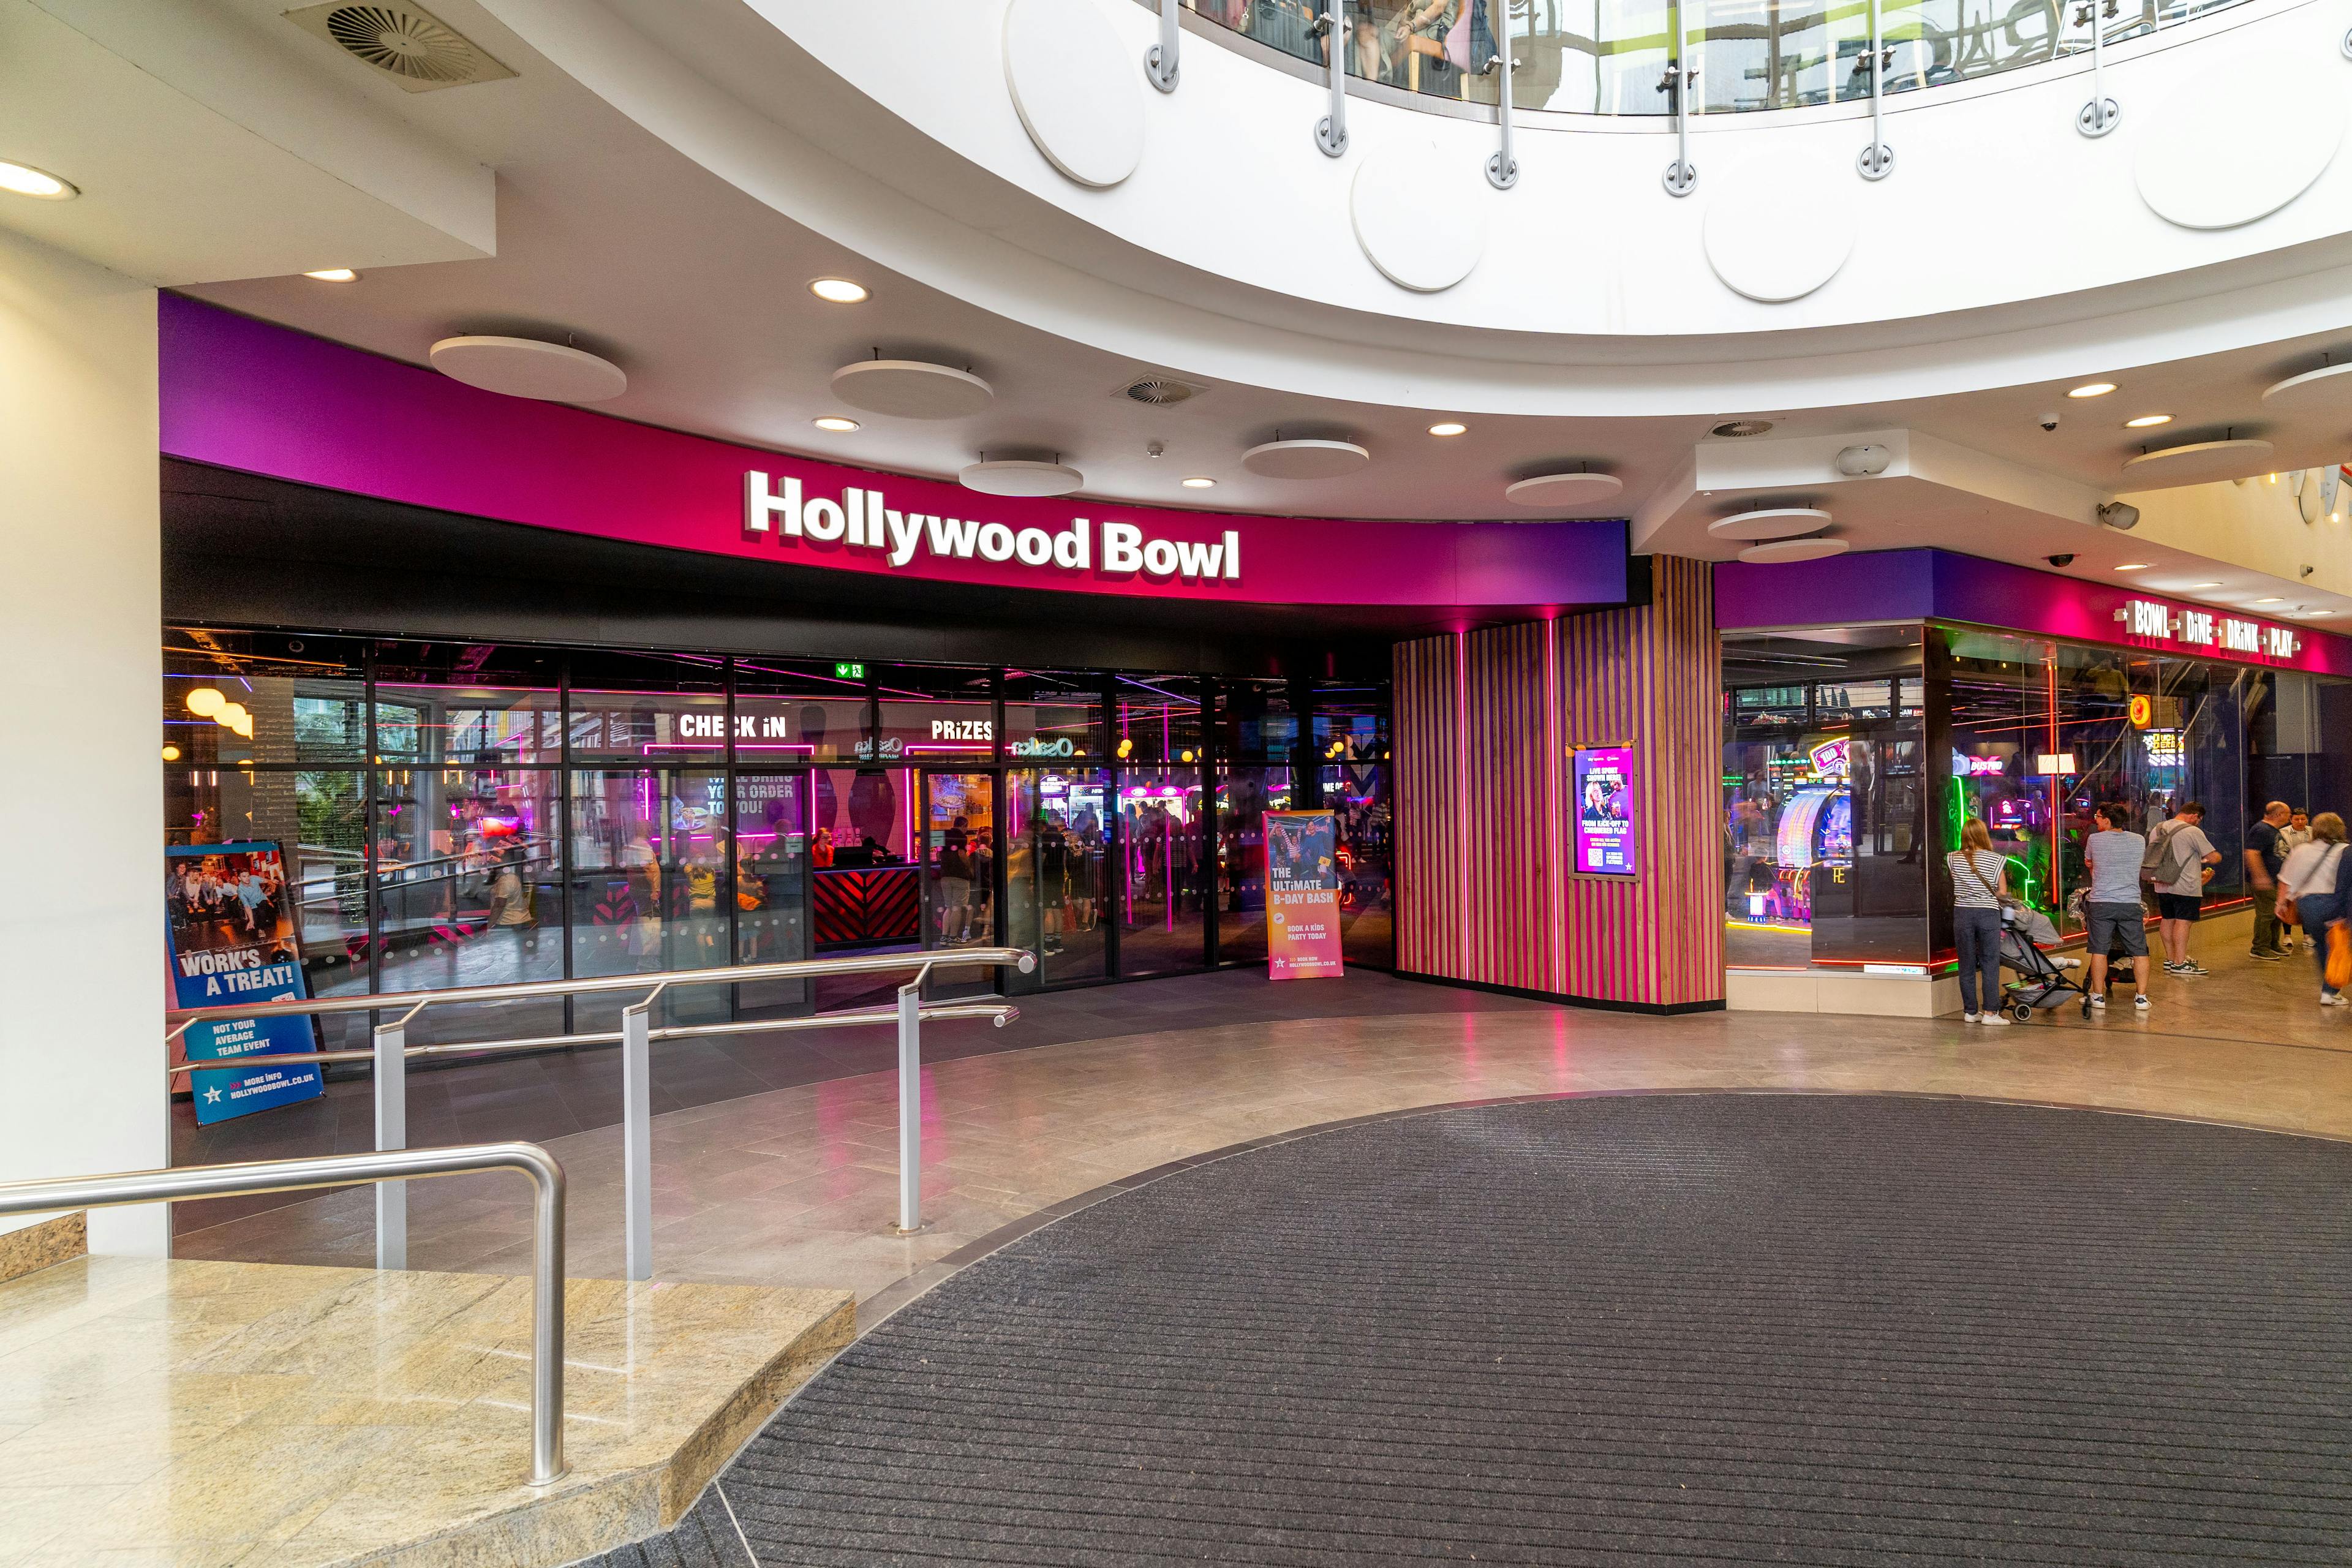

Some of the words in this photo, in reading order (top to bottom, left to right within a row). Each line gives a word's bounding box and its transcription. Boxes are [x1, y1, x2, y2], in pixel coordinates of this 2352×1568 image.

[745, 470, 1090, 567] Hollywood
[1101, 522, 1239, 579] Bowl
[2133, 600, 2171, 638] BOWL
[2271, 627, 2293, 658] PLAY
[707, 785, 746, 799] YOR
[749, 785, 793, 798] ORDER
[707, 801, 725, 815] TO
[736, 801, 763, 814] OU!
[1272, 867, 1291, 878] THE
[1273, 894, 1304, 905] B-DAY
[1306, 892, 1333, 903] BASH
[180, 949, 261, 977] WORK'S
[206, 977, 222, 997] A
[224, 965, 294, 993] TREAT!
[213, 1024, 230, 1035] NOT
[232, 1019, 255, 1031] YOUR
[216, 1031, 254, 1046] AVERAGE
[216, 1045, 242, 1057] TEAM
[244, 1039, 270, 1052] EVENT
[230, 1074, 314, 1099] HOLLYWOODBOWL.CO.UK
[244, 1076, 265, 1087] MORE
